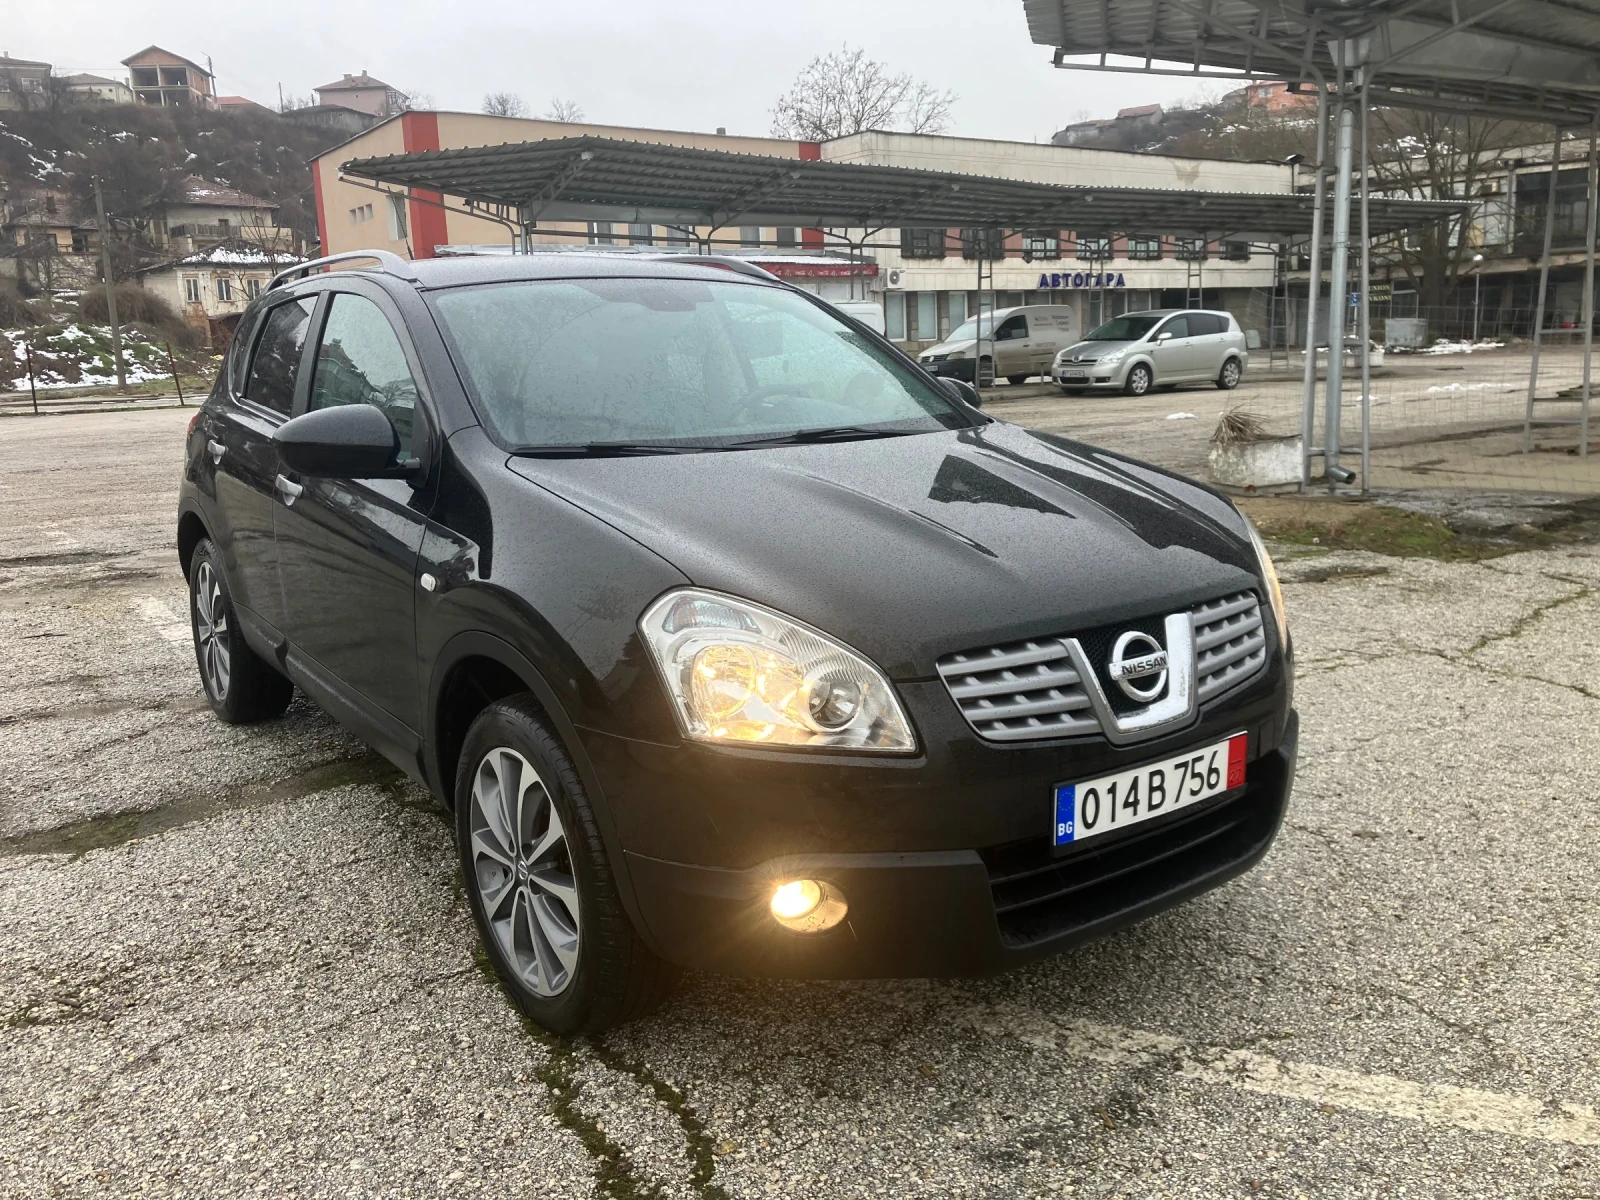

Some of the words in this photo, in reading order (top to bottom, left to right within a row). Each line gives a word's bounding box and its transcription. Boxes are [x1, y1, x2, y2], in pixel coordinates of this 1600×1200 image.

[1039, 272, 1126, 288] АВТОГАРА
[1120, 655, 1167, 676] NISSAN
[1058, 821, 1072, 837] BG
